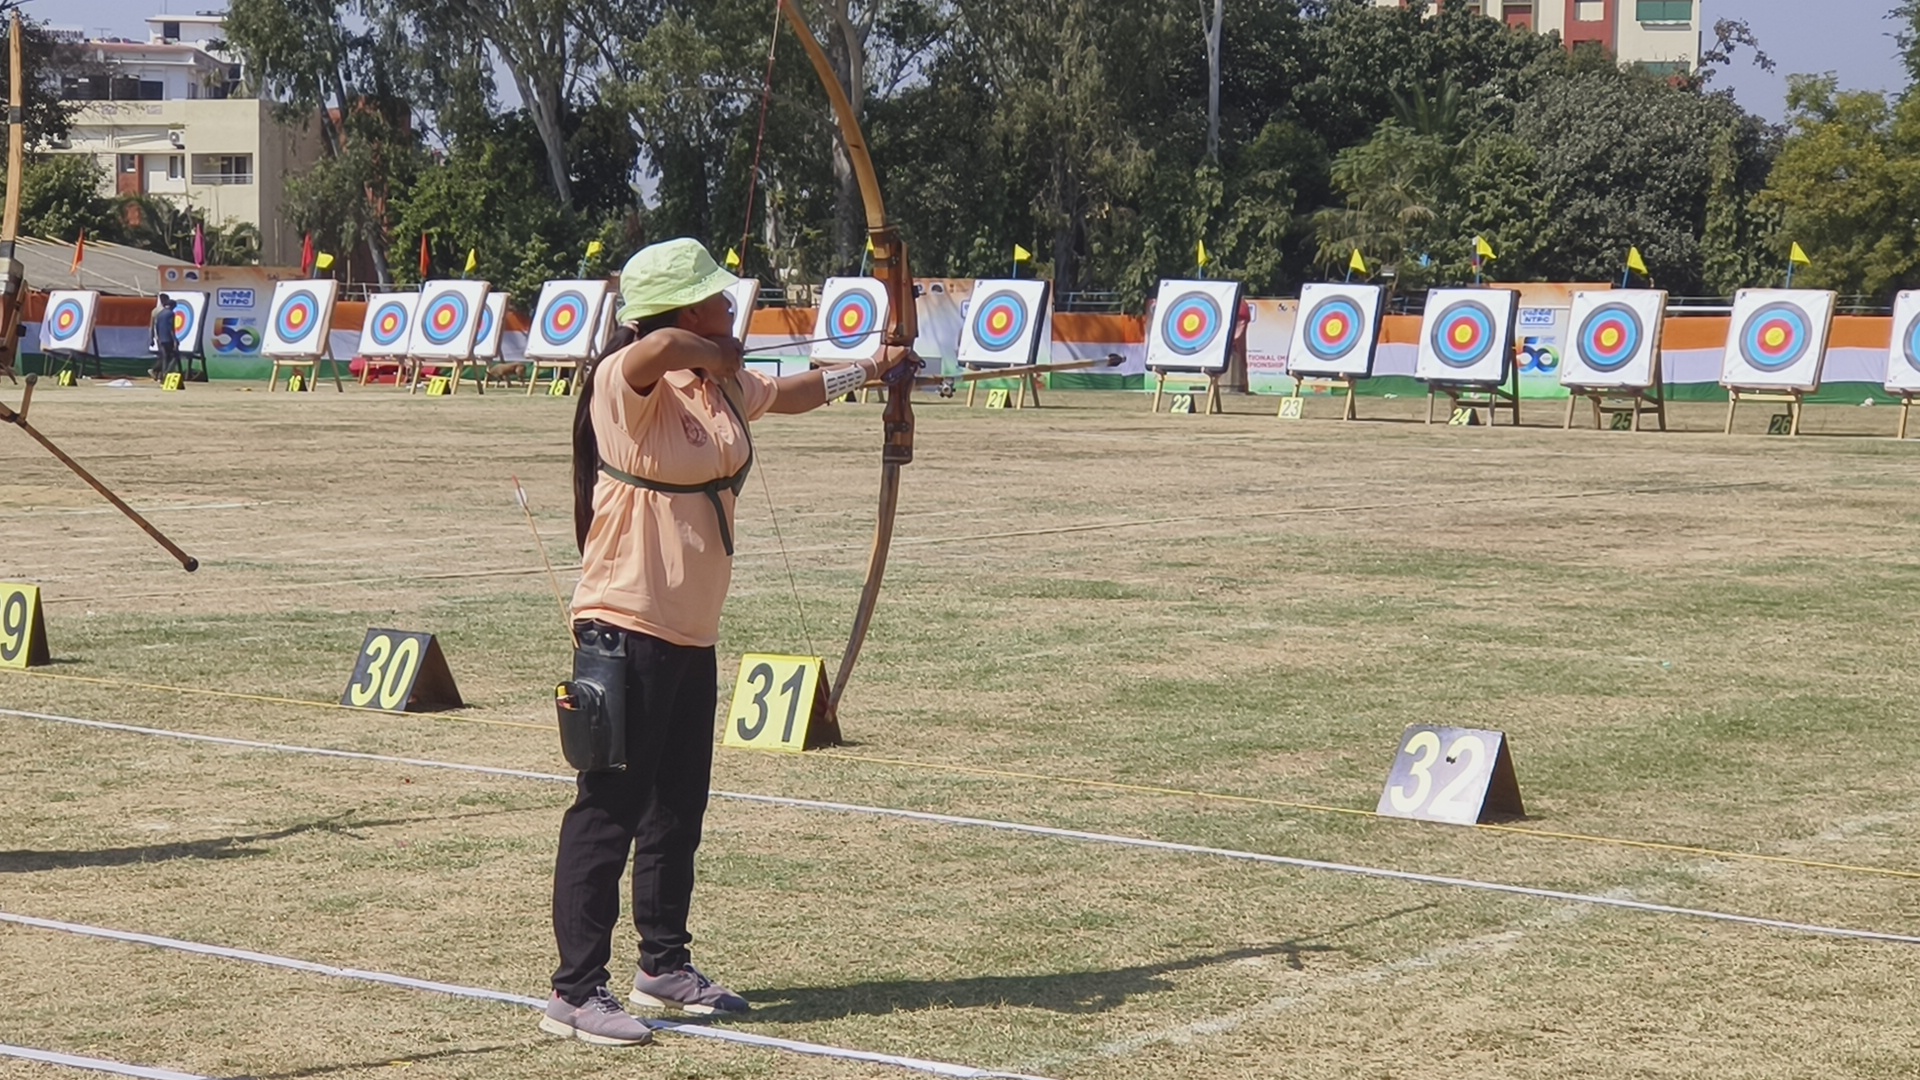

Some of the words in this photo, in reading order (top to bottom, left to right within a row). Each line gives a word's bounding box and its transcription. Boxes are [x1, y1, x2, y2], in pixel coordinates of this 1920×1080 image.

[59, 370, 72, 386] 14
[165, 374, 179, 390] 15
[288, 375, 302, 392] 16
[430, 378, 446, 394] 17
[548, 379, 567, 396] 18
[988, 391, 1006, 408] 21
[1170, 395, 1192, 414] 22
[1281, 399, 1300, 417] 23
[1449, 408, 1472, 426] 24
[1612, 412, 1633, 430] 25
[1770, 416, 1792, 434] 26
[0, 590, 27, 661] 9
[351, 634, 419, 709] 30
[737, 662, 806, 743] 31
[1390, 730, 1485, 818] 32
